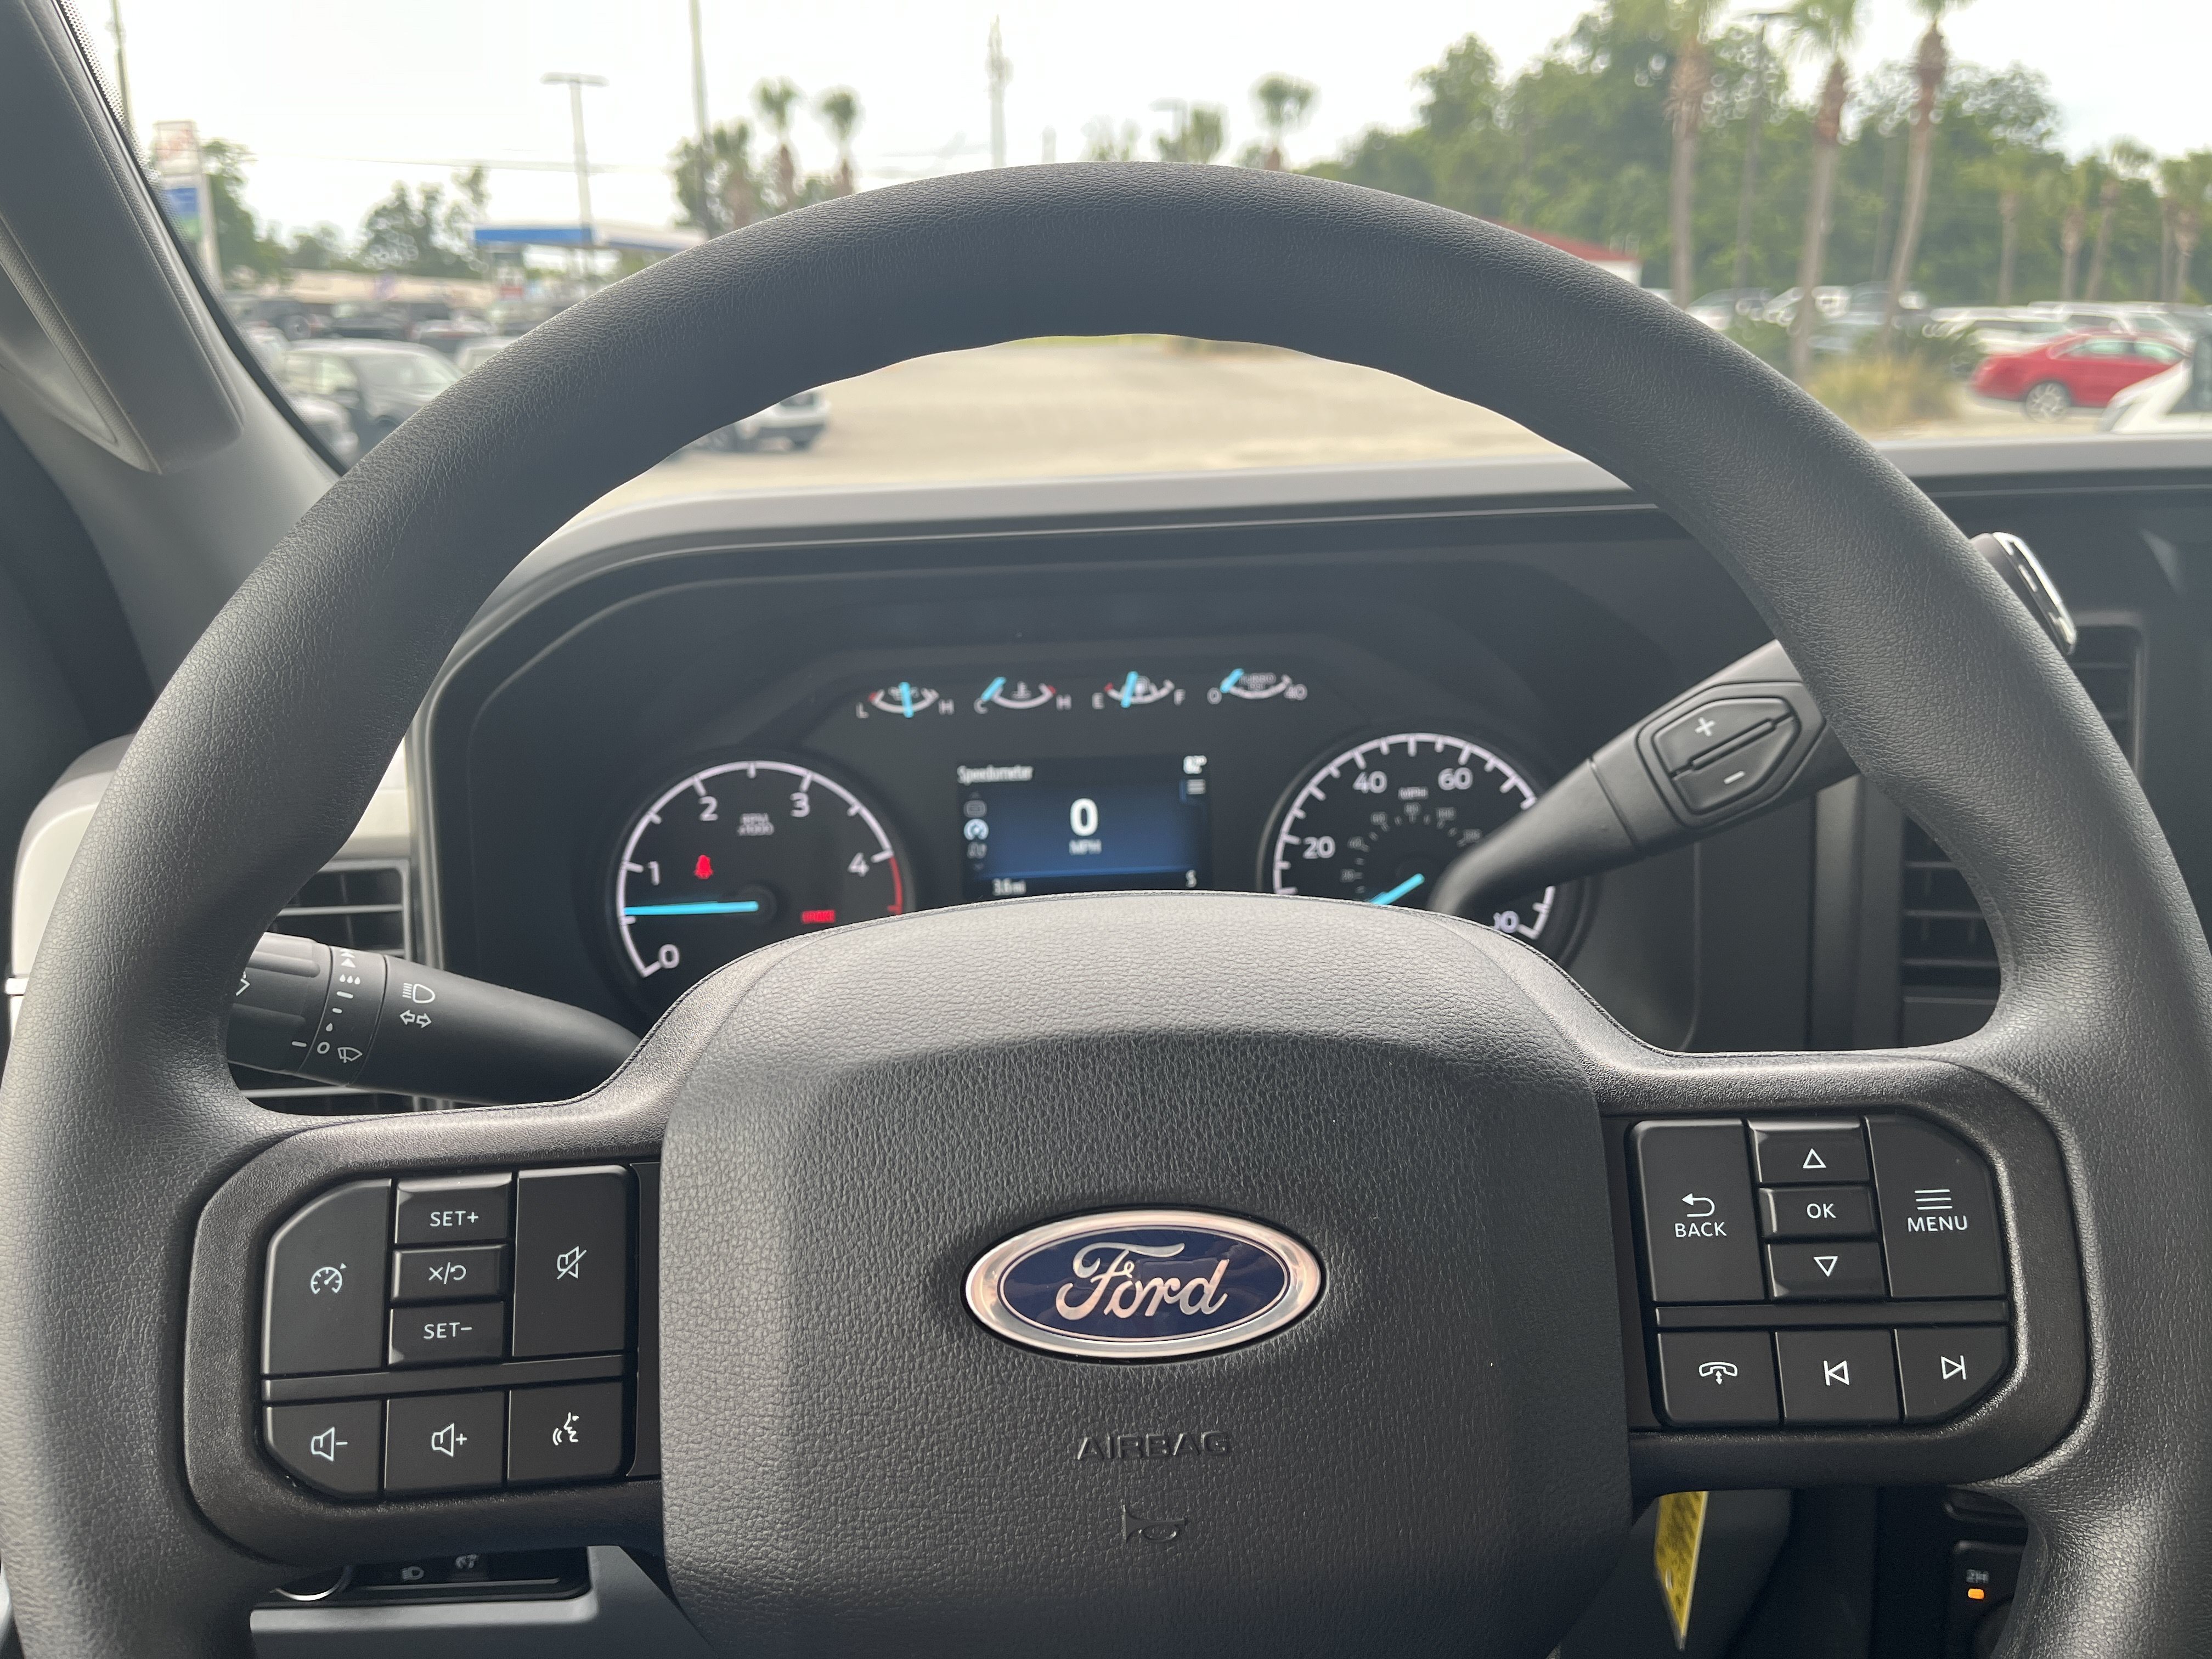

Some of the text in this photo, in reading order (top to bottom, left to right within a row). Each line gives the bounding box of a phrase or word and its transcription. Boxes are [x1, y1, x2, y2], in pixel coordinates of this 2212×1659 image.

[1092, 692, 1105, 709] E
[1173, 689, 1186, 706] F
[1284, 684, 1308, 701] 40
[856, 703, 869, 718] L
[939, 699, 954, 715] H
[974, 698, 988, 714] C
[1056, 695, 1071, 710] H
[957, 765, 1034, 786] Speedometer
[1353, 771, 1387, 794] 40
[1438, 768, 1473, 791] 60
[699, 796, 718, 821] 2
[790, 793, 810, 817] 3
[1070, 798, 1098, 836] 0
[1069, 839, 1102, 855] MPH
[1303, 836, 1335, 859] 20
[647, 861, 660, 885] 1
[848, 853, 870, 877] 4
[658, 944, 679, 968] 0
[429, 1211, 479, 1227] SET+
[1806, 1203, 1837, 1219] OK
[1674, 1221, 1728, 1238] BACK
[1906, 1215, 1969, 1233] MENU
[1055, 1242, 1231, 1321] Ford
[1076, 1430, 1231, 1460] AIRBAG
